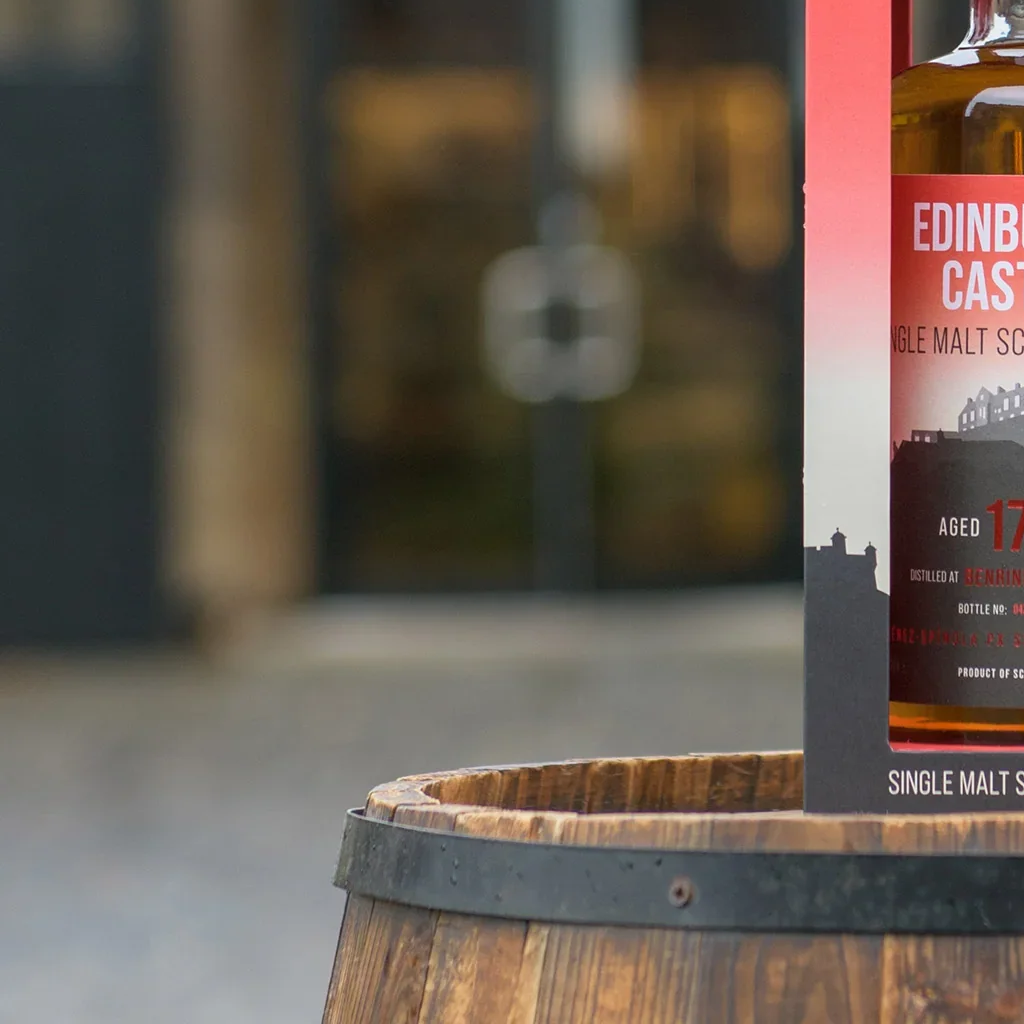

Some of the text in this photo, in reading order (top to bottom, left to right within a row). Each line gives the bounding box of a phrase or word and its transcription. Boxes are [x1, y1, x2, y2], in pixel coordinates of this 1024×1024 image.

[933, 326, 988, 355] MALT
[938, 517, 980, 537] AGED
[910, 568, 947, 583] DISTILLED
[948, 570, 959, 584] AT
[958, 603, 990, 615] BOTTLE
[957, 667, 997, 678] PRODUCT
[999, 668, 1010, 679] OF
[888, 769, 954, 796] SINGLE
[959, 770, 1009, 796] MALT
